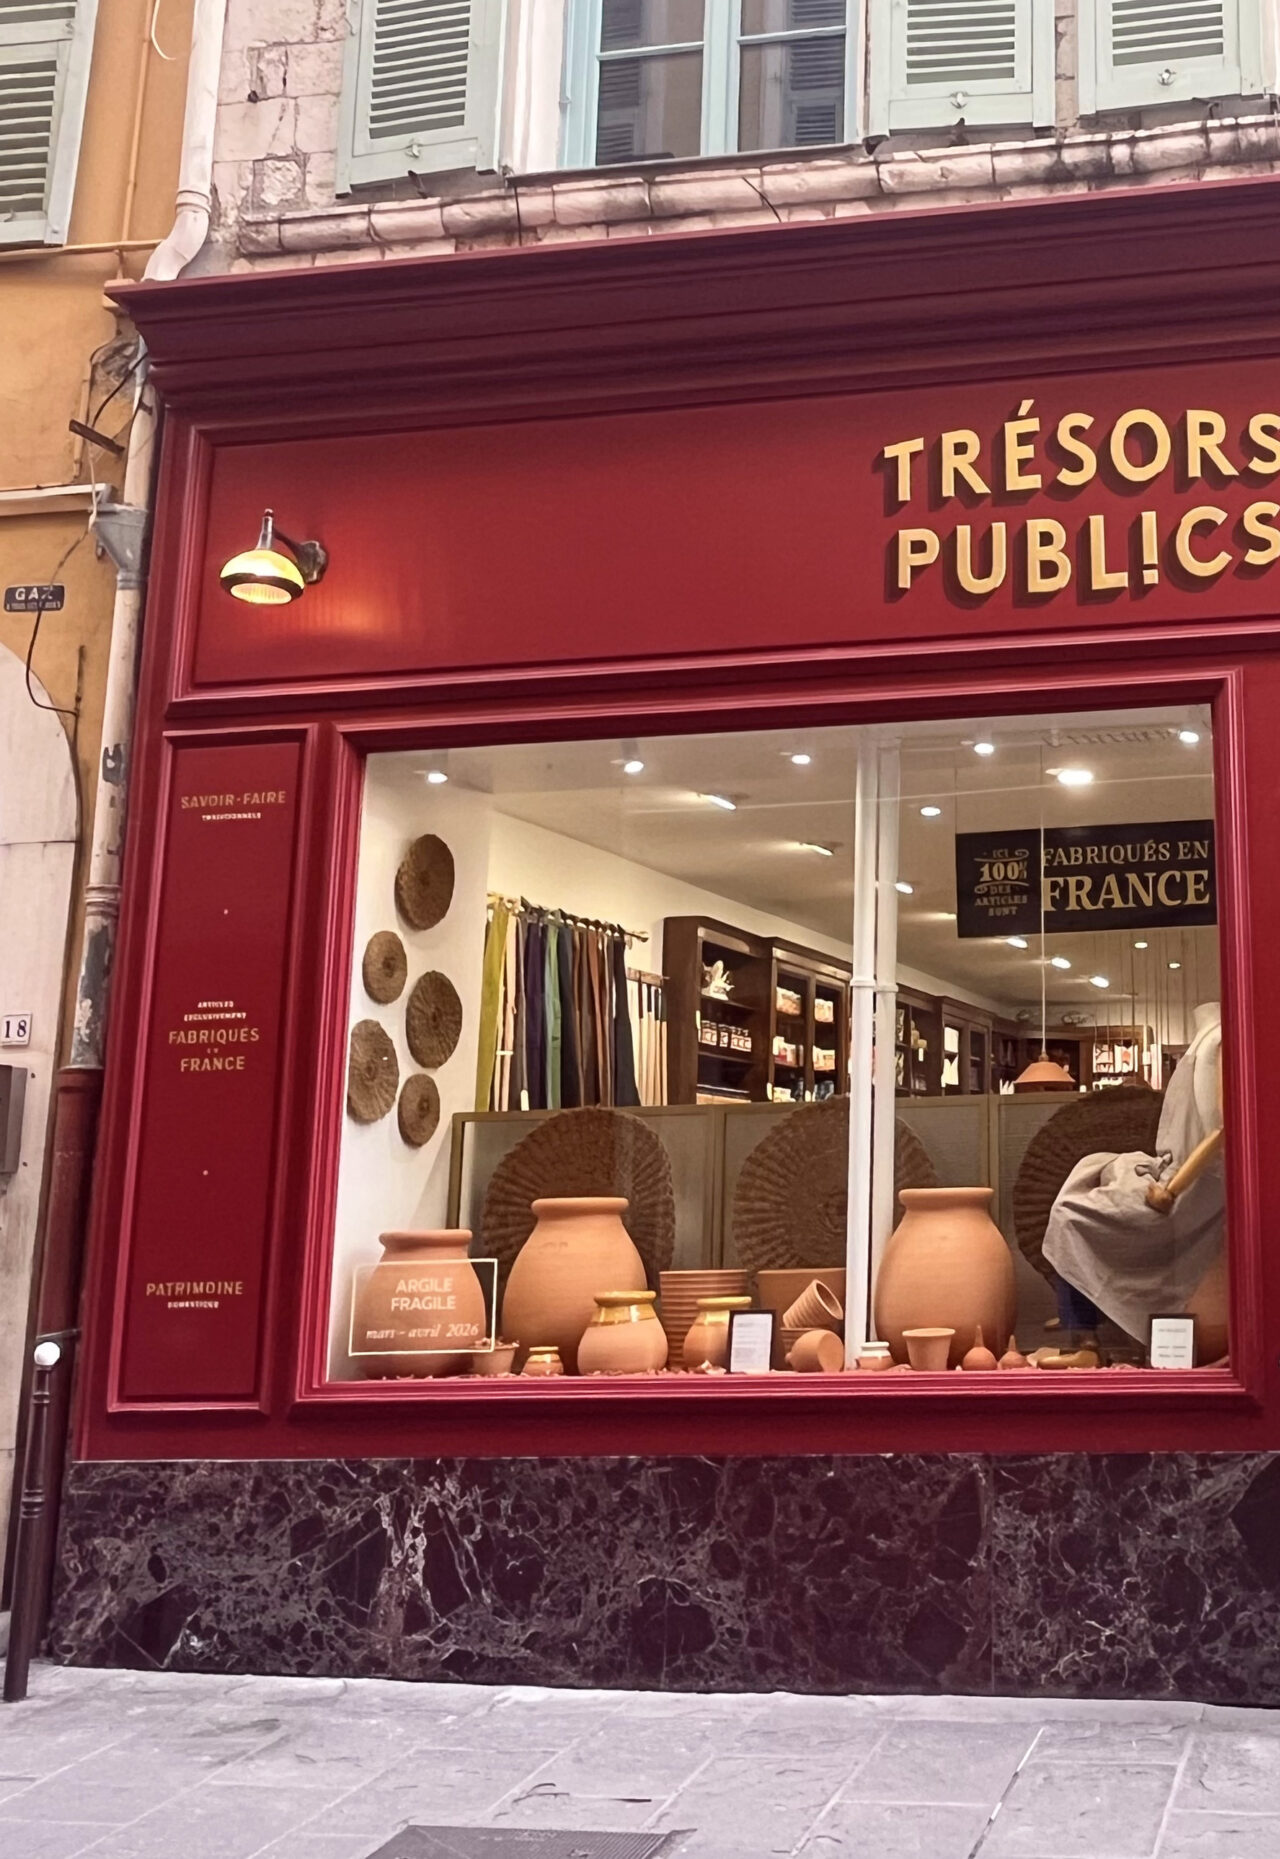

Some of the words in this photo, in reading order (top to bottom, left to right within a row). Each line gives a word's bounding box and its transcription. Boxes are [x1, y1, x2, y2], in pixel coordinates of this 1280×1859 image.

[1043, 840, 1170, 867] FABRIQUÉS
[1178, 840, 1209, 860] EN
[1043, 870, 1210, 911] FRANCE
[5, 1019, 27, 1038] 18
[181, 1056, 245, 1072] FRANCE
[146, 1281, 243, 1296] PATRIMOINE
[395, 1278, 453, 1294] ARGILE
[391, 1296, 456, 1311] FRAGILE
[408, 1324, 441, 1338] avril
[446, 1323, 479, 1338] 2026
